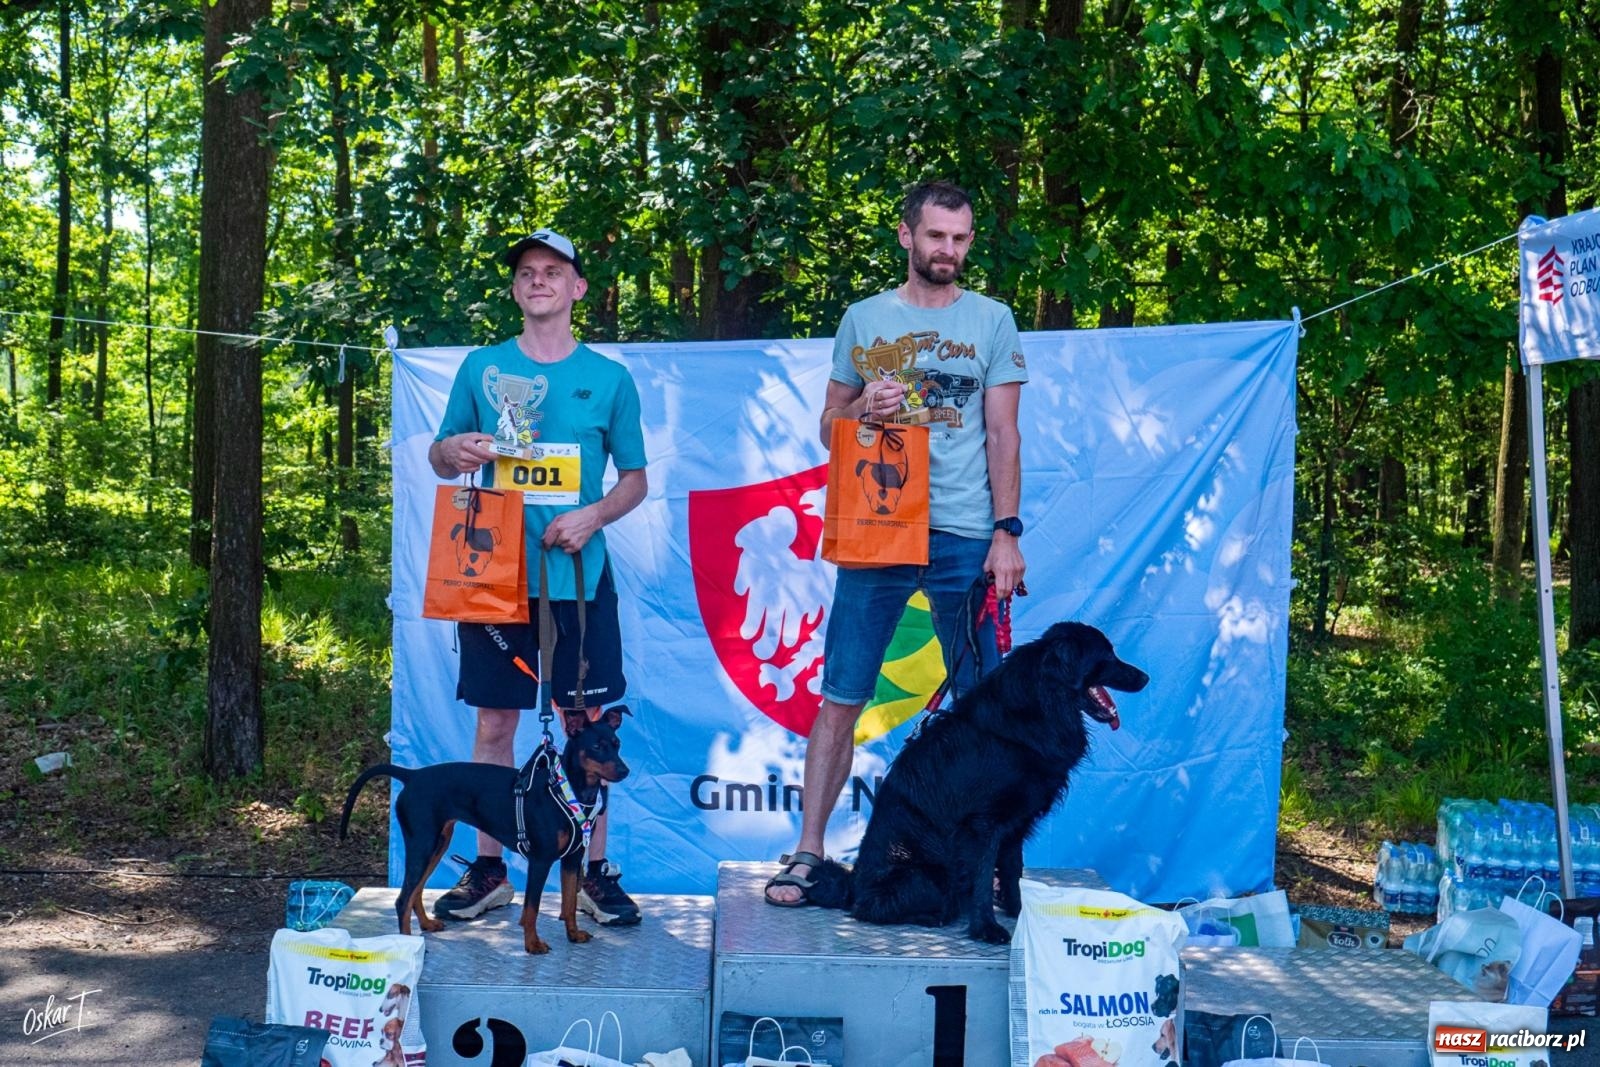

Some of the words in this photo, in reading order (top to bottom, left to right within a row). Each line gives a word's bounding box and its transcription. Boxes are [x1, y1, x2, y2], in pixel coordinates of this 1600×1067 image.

[1570, 256, 1597, 276] PLAN
[513, 465, 562, 486] 001
[689, 773, 804, 812] Gmin
[1062, 937, 1145, 960] TropiDog
[307, 966, 386, 995] TropiDog
[1059, 991, 1149, 1017] SALMON
[1105, 1016, 1155, 1029] ŁOSOSIA
[325, 1036, 373, 1049] OWINA
